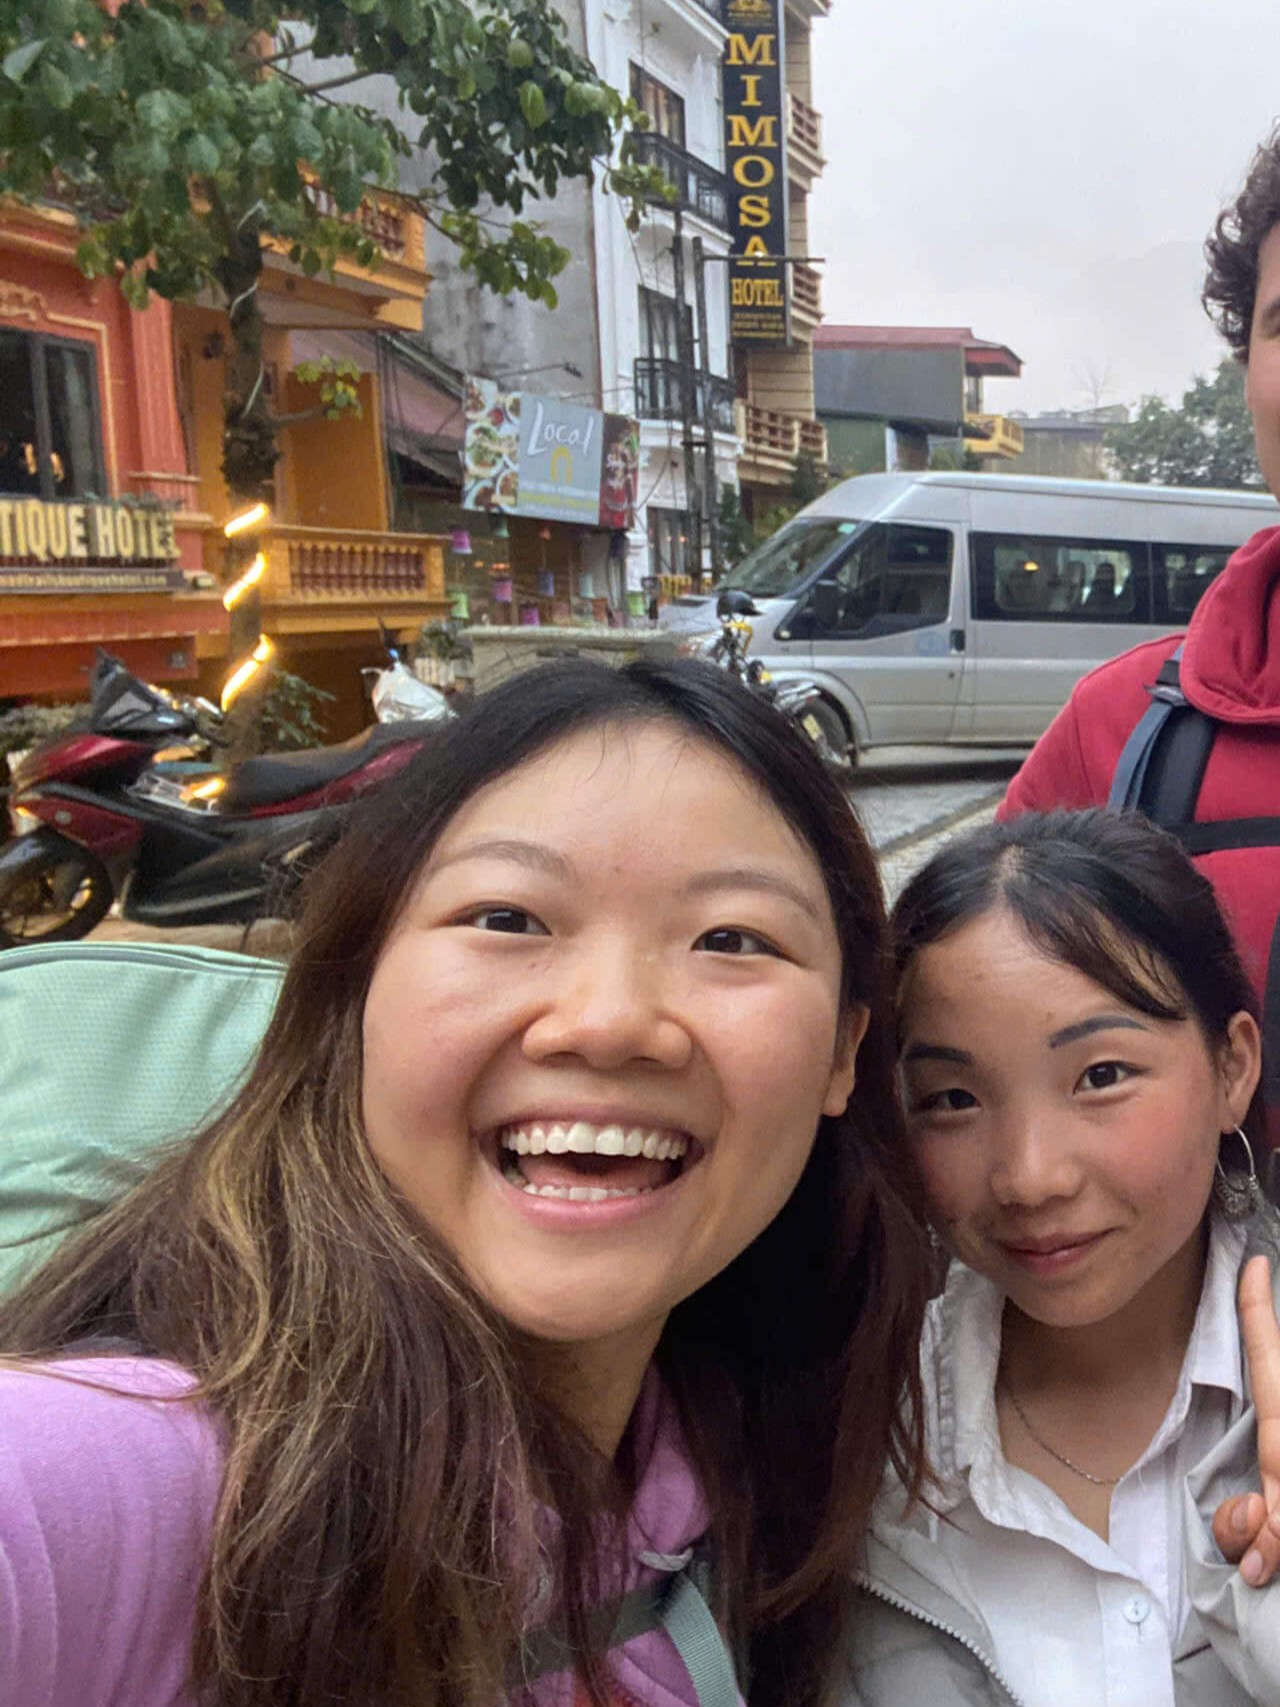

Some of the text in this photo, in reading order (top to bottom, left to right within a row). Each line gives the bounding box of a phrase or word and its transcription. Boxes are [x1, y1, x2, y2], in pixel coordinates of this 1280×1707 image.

[725, 33, 778, 266] MIMOSA
[731, 278, 785, 307] HOTEL
[527, 401, 594, 456] Local
[0, 499, 182, 562] TIQUE HOTEL
